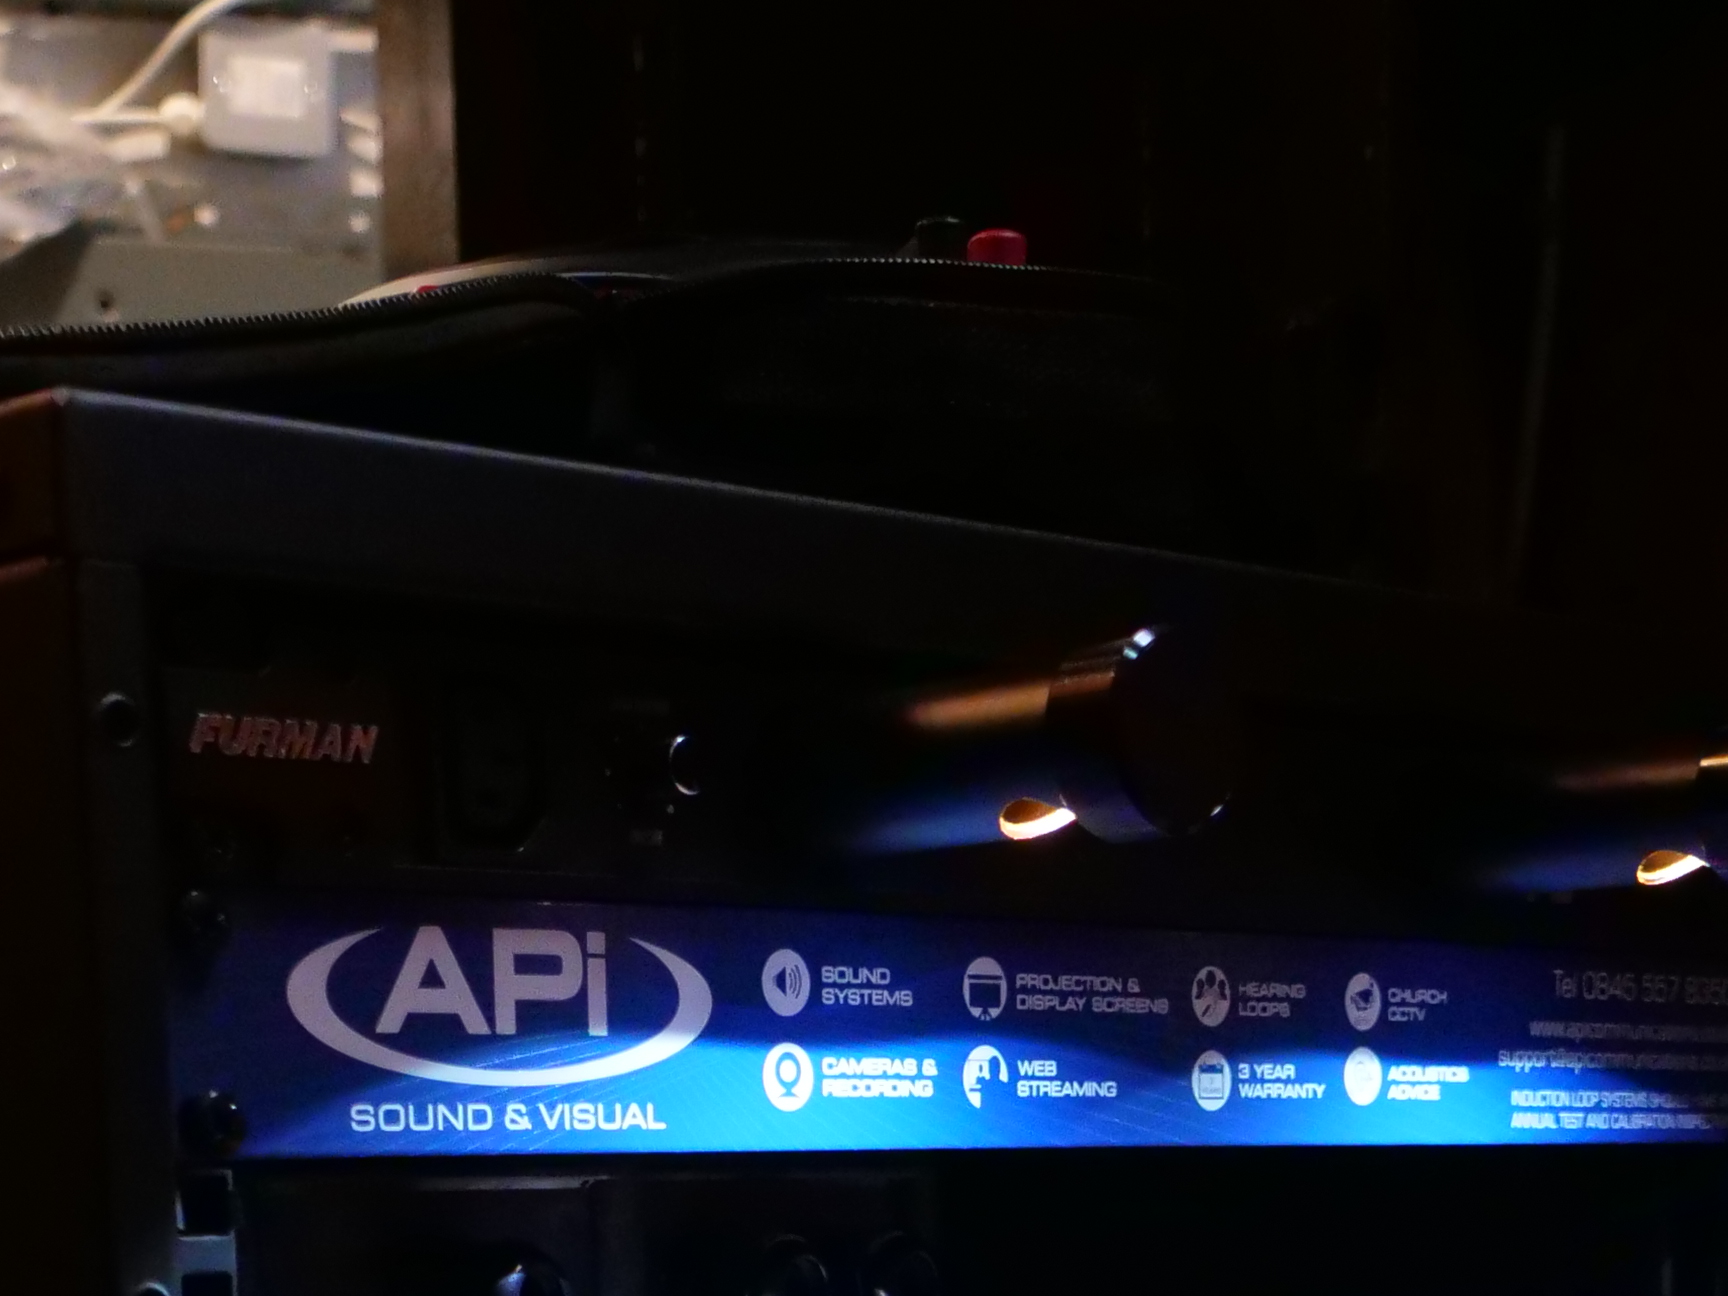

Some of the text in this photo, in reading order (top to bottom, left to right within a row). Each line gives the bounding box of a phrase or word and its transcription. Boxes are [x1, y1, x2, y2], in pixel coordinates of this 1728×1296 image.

[189, 712, 379, 764] FURMAN
[821, 966, 890, 985] SOUND
[1016, 973, 1140, 993] PROJECTION &
[821, 988, 913, 1007] SYSTEMS
[1238, 982, 1306, 999] HEARING
[1387, 987, 1447, 1005] CHURCH
[1016, 993, 1169, 1015] DISPLAY SCREENS
[1238, 1002, 1291, 1018] LOOPS
[1387, 1006, 1426, 1022] CCTV
[821, 1057, 938, 1077] CAMERAS &
[1017, 1060, 1057, 1077] WEB
[1238, 1063, 1296, 1080] 3 YEAR
[1387, 1065, 1470, 1083] ACOUSTICS
[821, 1077, 934, 1098] RECORDING
[1017, 1078, 1117, 1098] STREAMING
[1238, 1083, 1326, 1100] WARRANTY
[1387, 1083, 1441, 1101] ADVICE
[350, 1101, 667, 1132] SOUND & VISUAL
